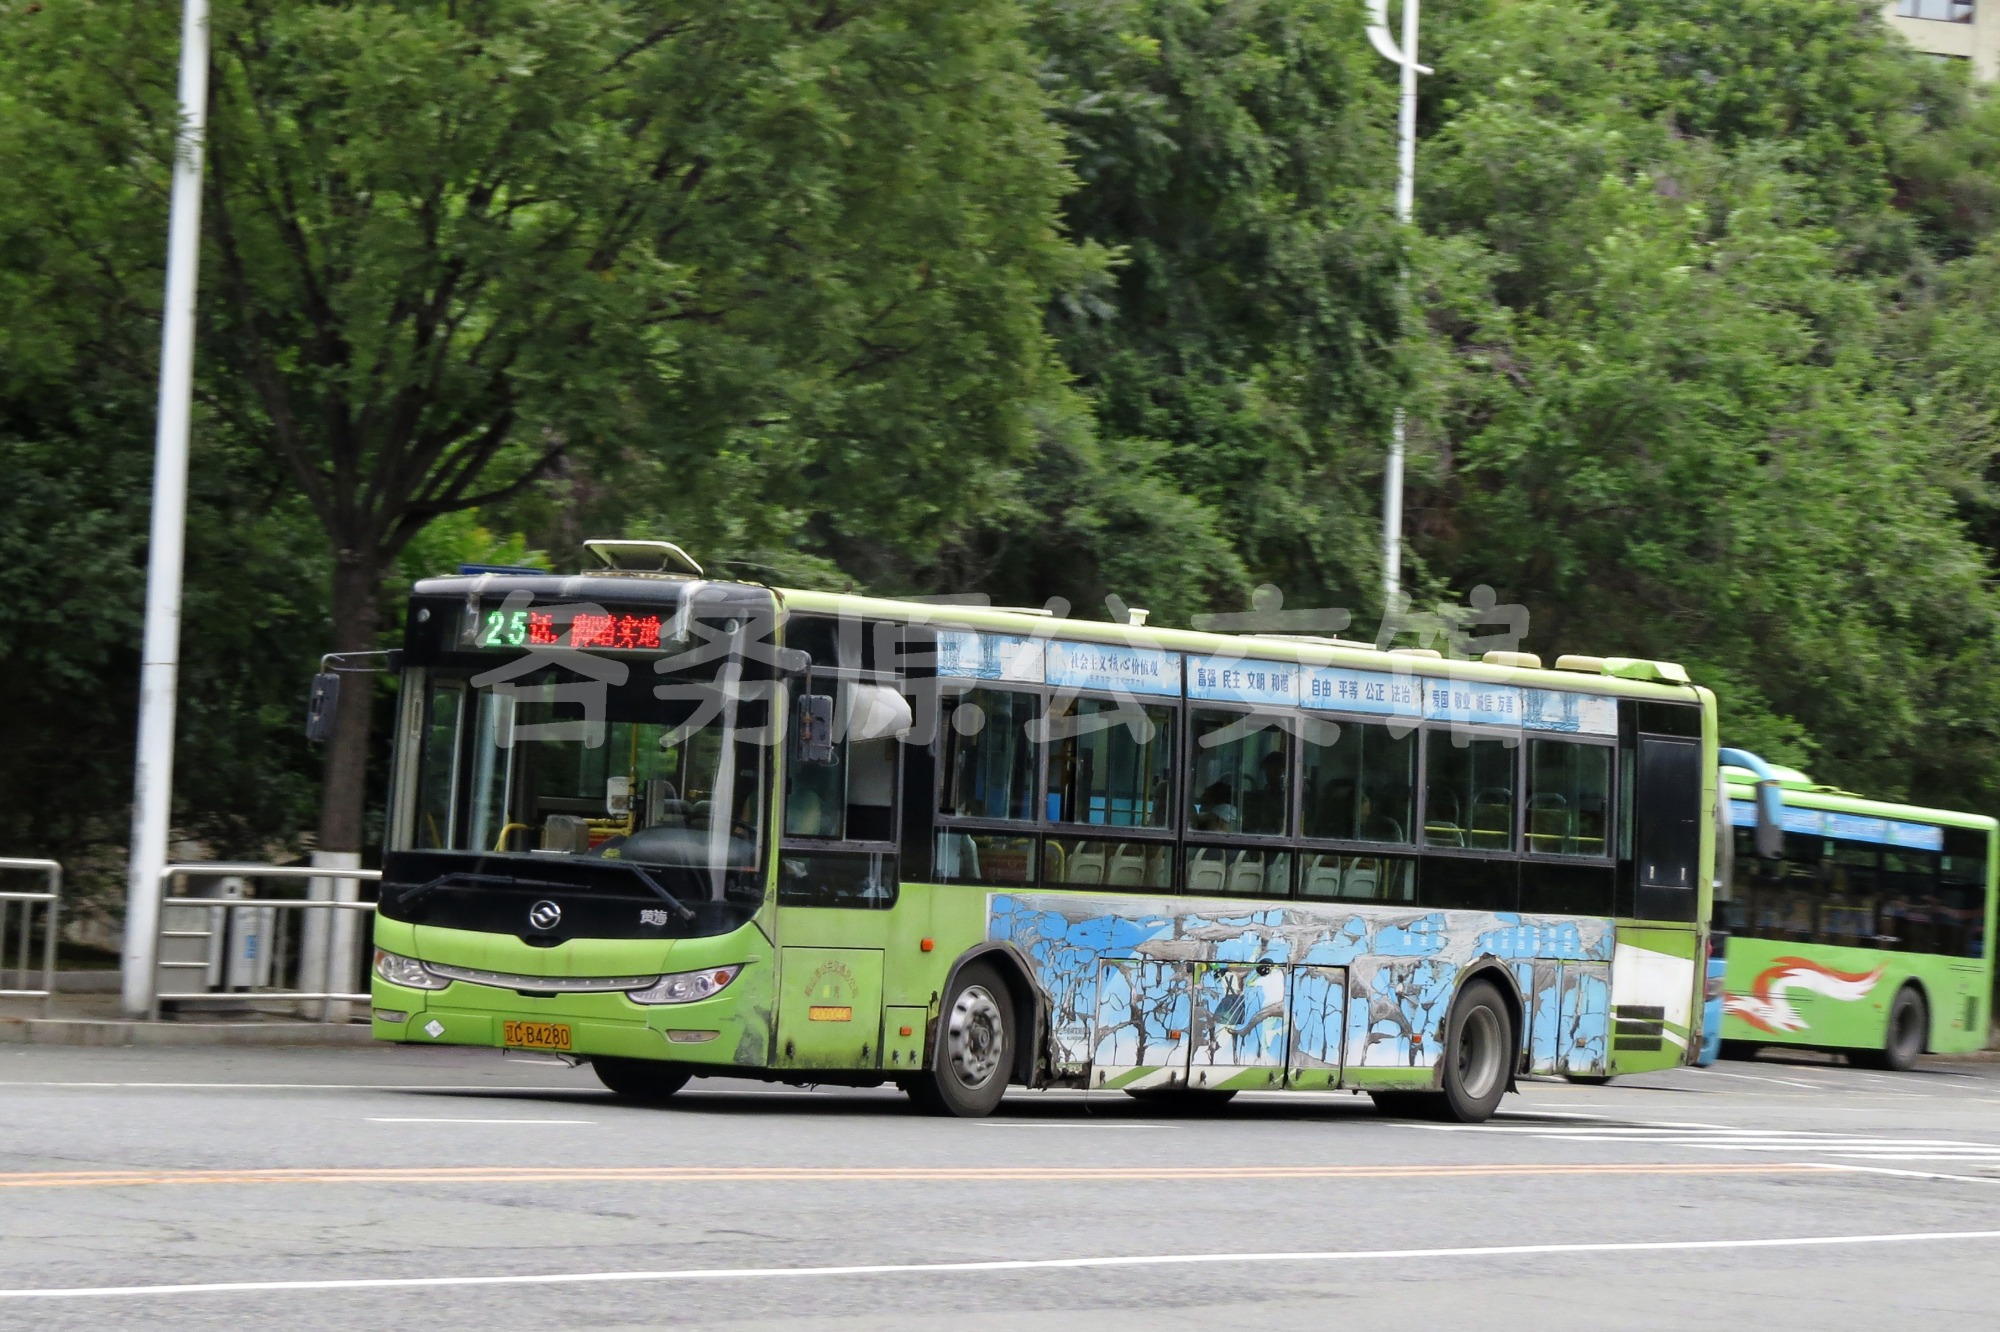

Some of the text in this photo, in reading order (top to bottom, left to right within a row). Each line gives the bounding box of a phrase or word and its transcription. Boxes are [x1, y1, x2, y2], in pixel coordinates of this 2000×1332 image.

[486, 611, 528, 645] 25
[1070, 652, 1158, 677] 社会主义核心价值观
[1197, 668, 1289, 693] 富强 民主 文明 和谐
[1312, 678, 1411, 704] 自由 平等 公正 法治
[1432, 690, 1449, 709] 爱国
[1497, 695, 1514, 714] 友善
[640, 909, 668, 925] 黄海
